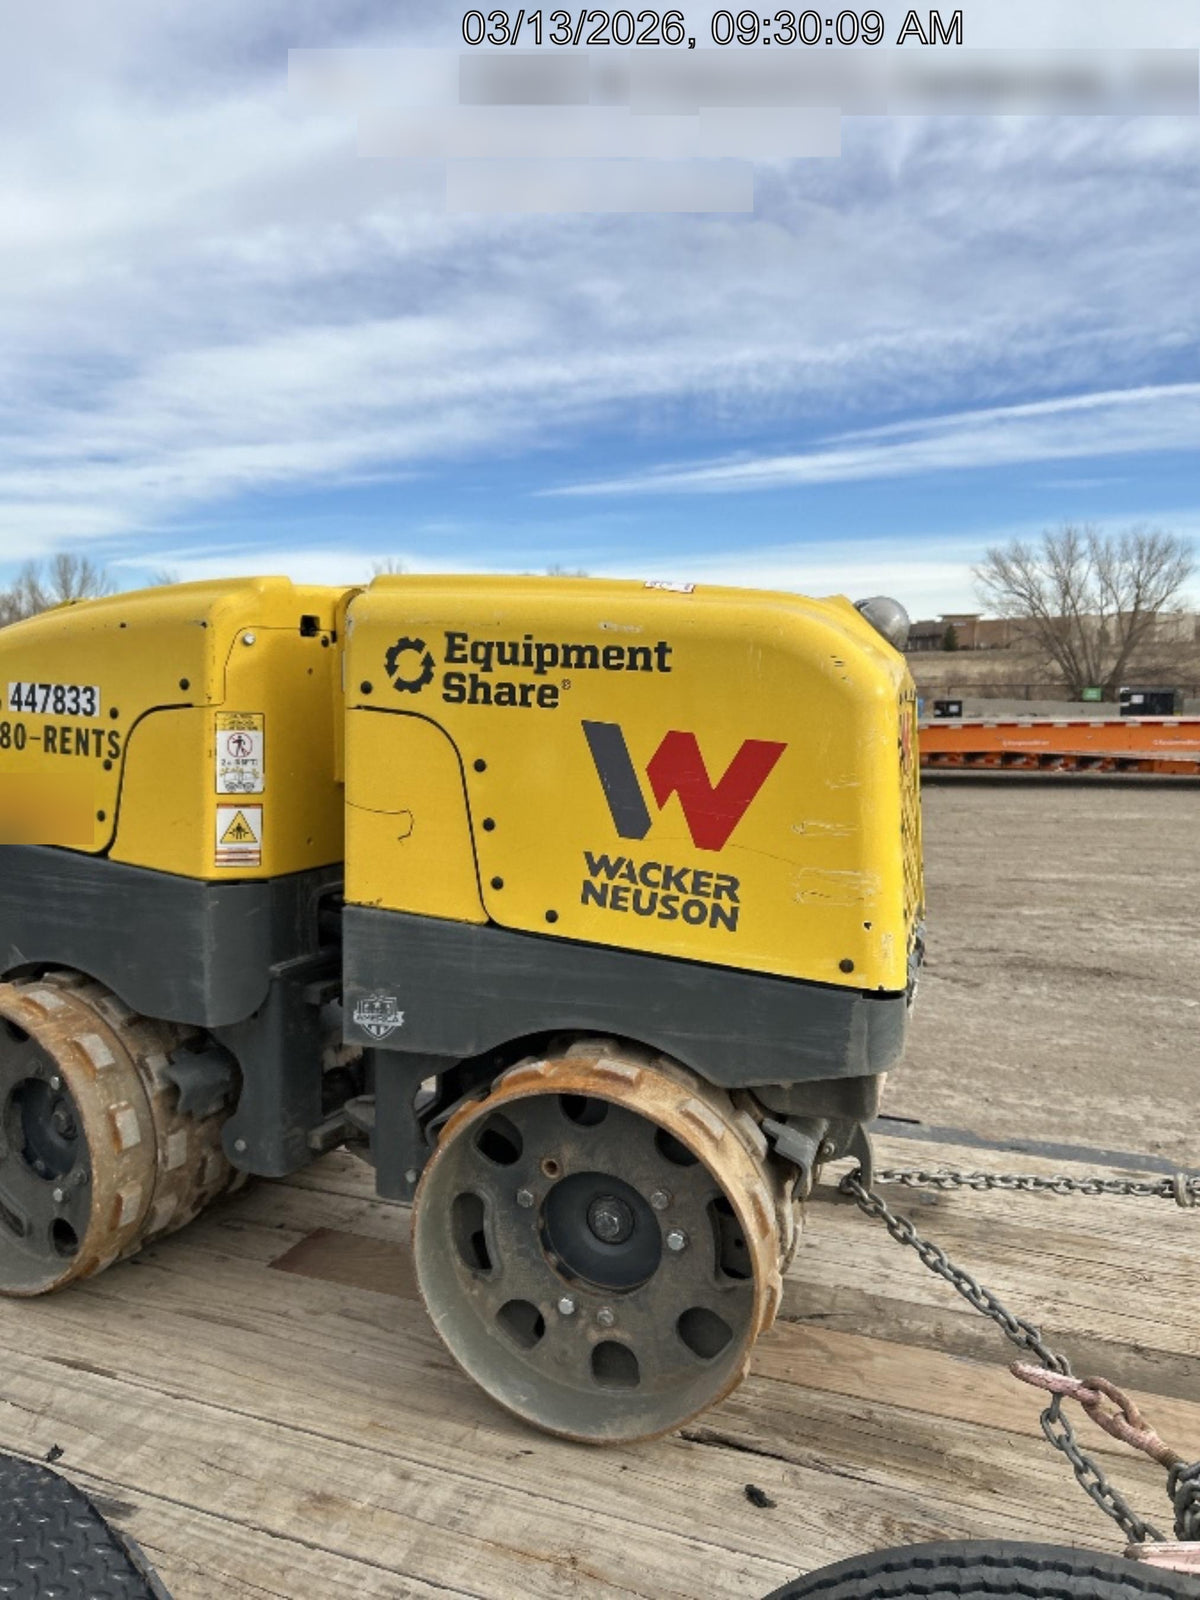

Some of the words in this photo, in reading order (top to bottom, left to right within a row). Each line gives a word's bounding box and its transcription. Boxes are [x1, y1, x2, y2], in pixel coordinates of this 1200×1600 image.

[444, 631, 673, 675] Equipment
[10, 682, 96, 717] 447833
[0, 721, 121, 759] 80-RENTS
[583, 851, 740, 904] WACKER
[580, 879, 740, 932] NEUSON
